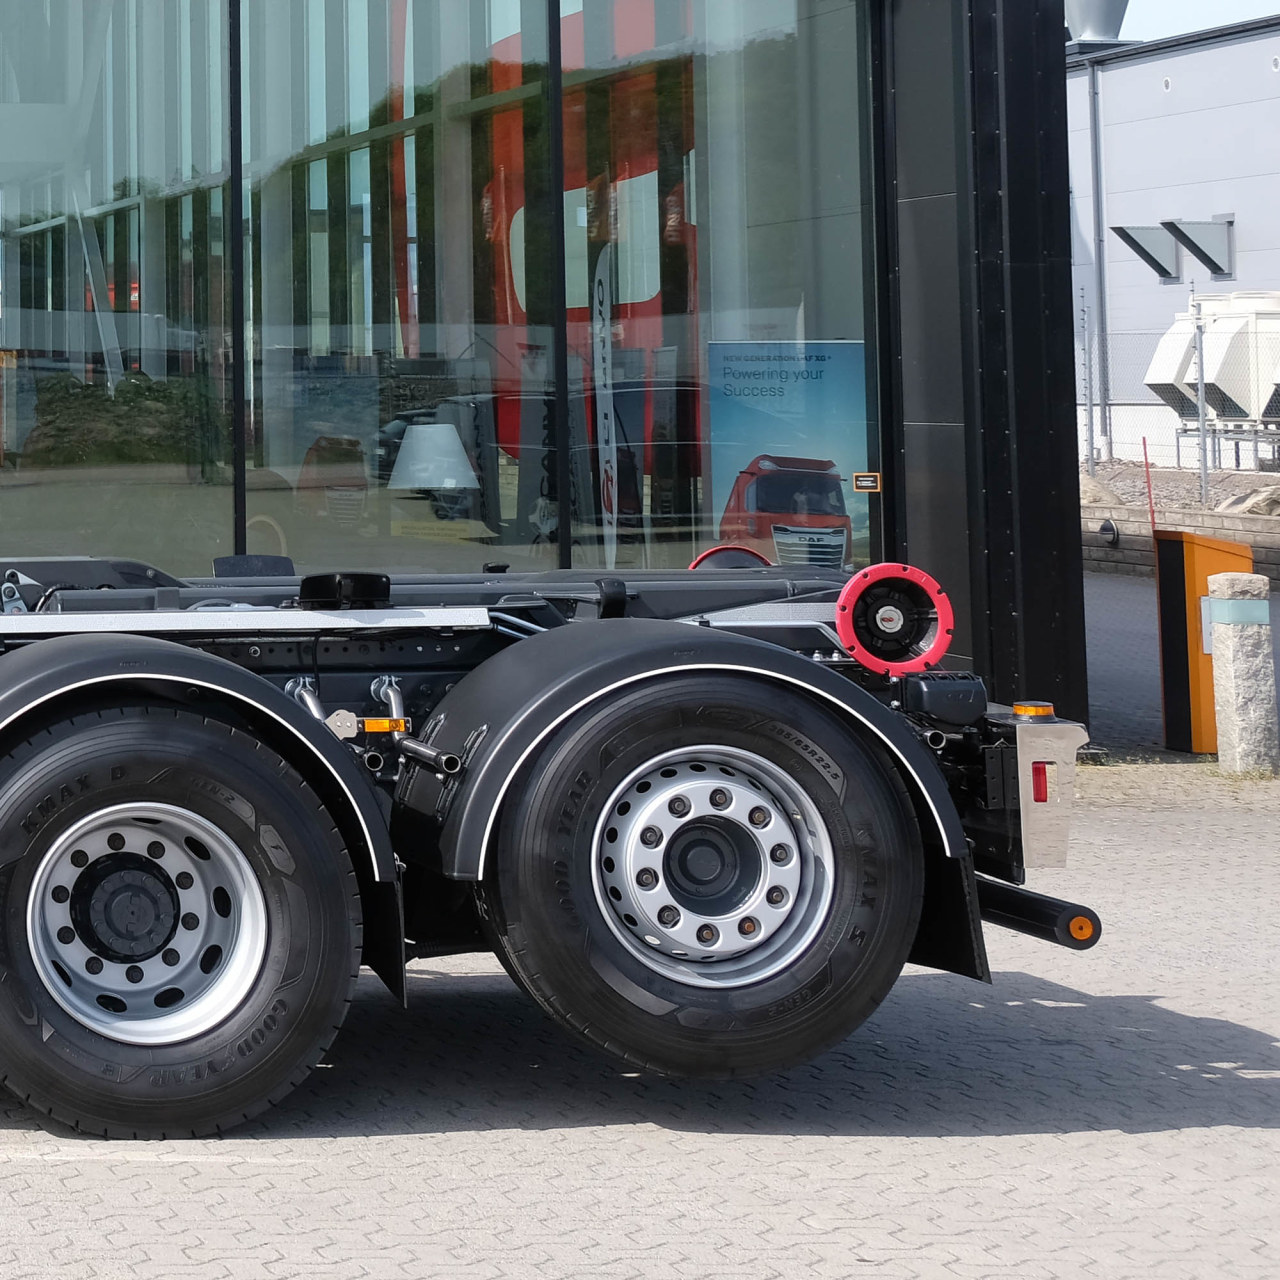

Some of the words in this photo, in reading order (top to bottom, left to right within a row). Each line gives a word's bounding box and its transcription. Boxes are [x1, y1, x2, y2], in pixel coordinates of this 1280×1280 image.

[723, 366, 789, 383] Powering
[792, 369, 824, 383] your
[723, 383, 785, 397] Success
